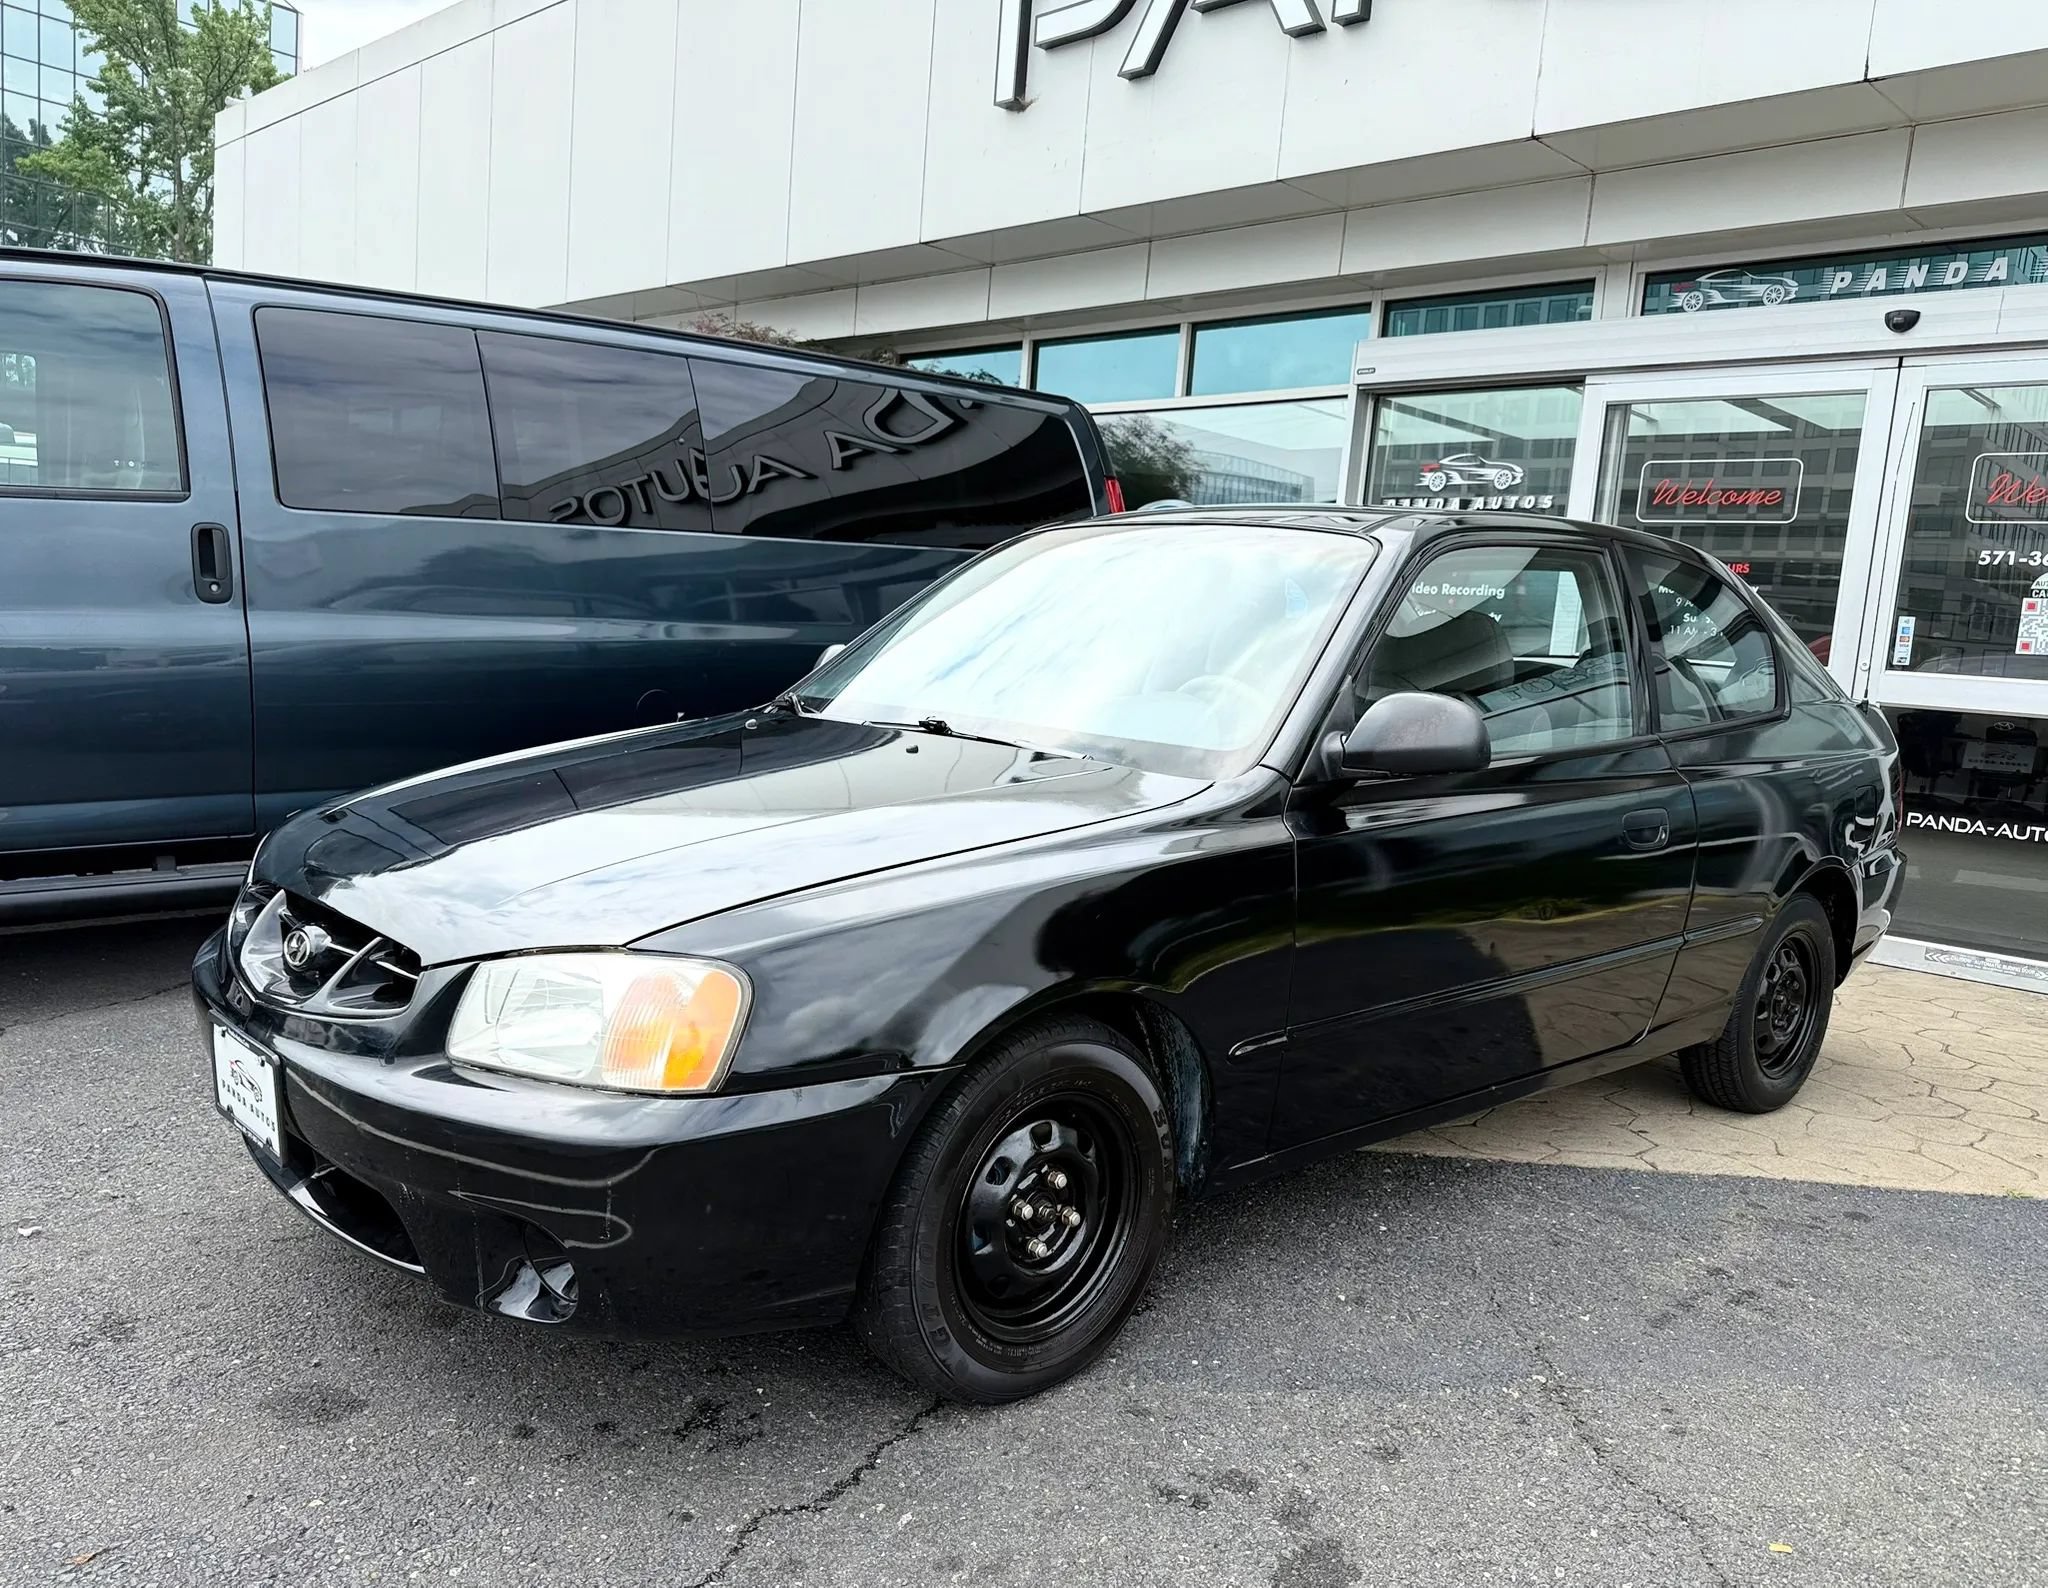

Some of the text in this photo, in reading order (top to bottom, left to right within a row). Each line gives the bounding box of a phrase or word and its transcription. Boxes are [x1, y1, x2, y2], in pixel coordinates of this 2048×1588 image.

[1829, 256, 2009, 295] PANDA
[1468, 494, 1554, 511] AUTOS
[1652, 478, 1783, 506] Welcome
[1441, 583, 1506, 600] Recording
[2032, 589, 2048, 598] CA
[1906, 811, 2048, 842] PANDA-AUT
